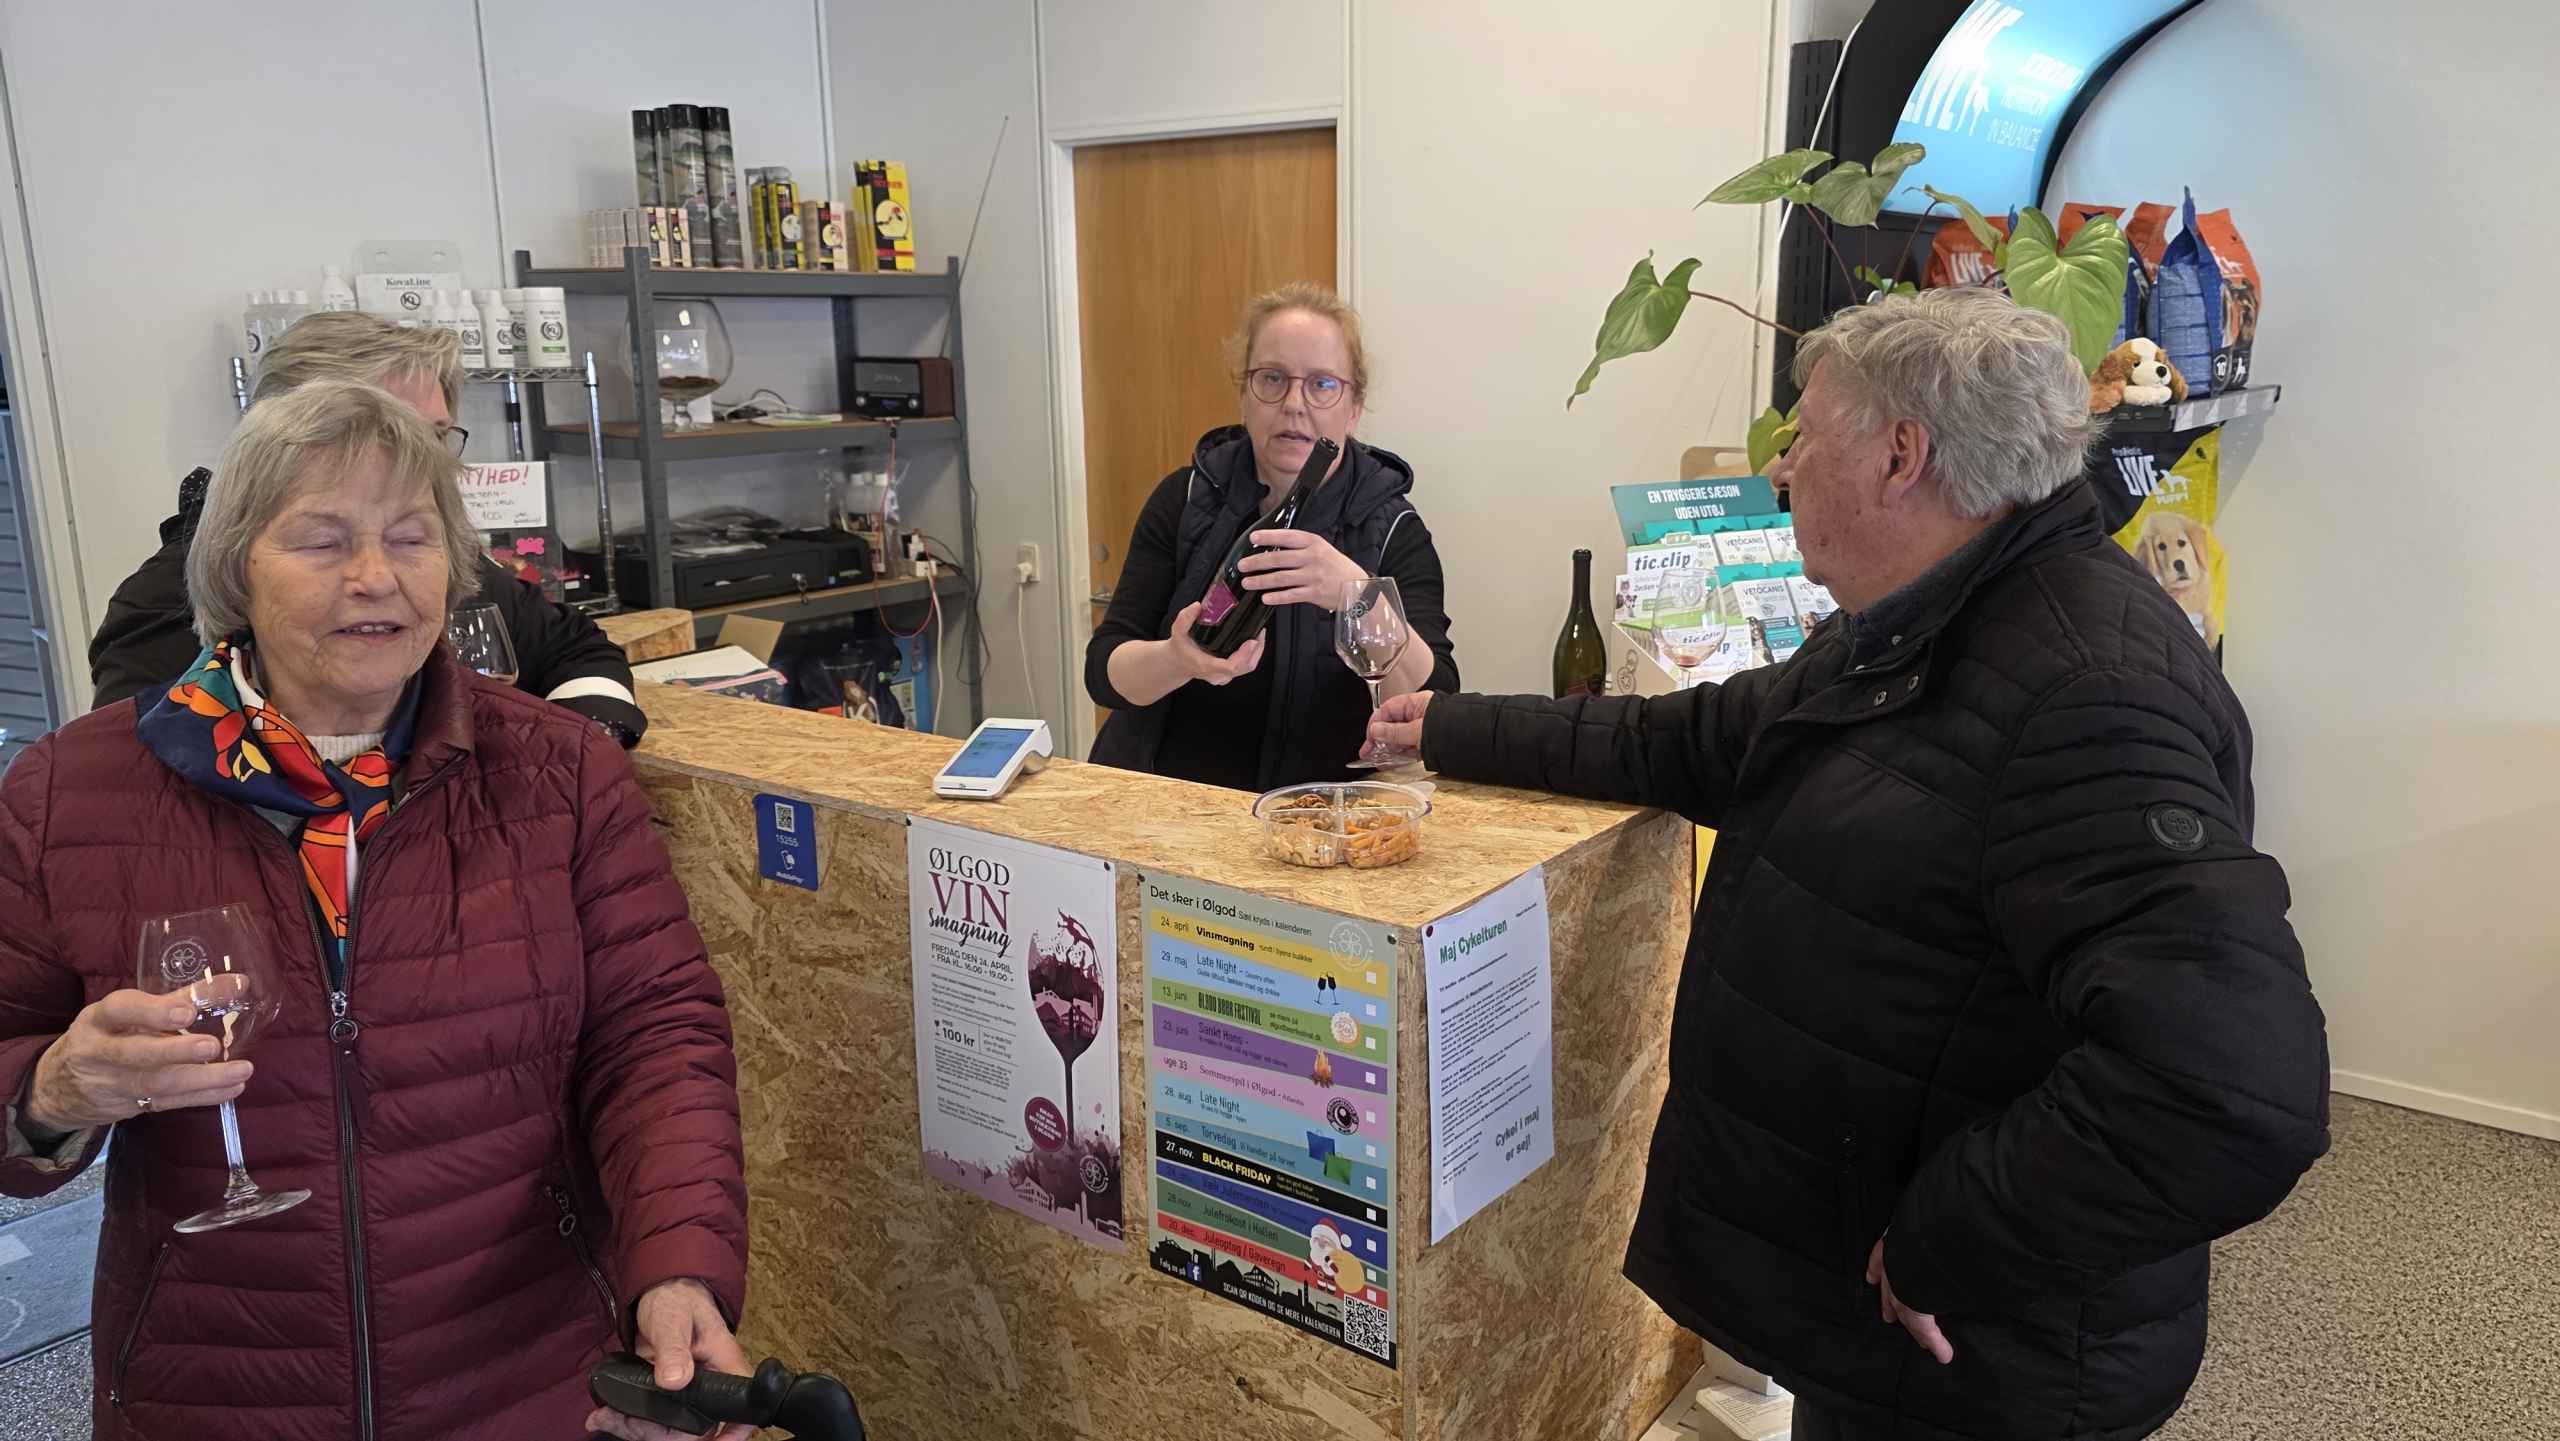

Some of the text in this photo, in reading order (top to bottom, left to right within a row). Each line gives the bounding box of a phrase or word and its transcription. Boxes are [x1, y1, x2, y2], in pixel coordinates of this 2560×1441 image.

[2115, 454, 2165, 497] LIVE
[1647, 485, 1740, 503] EN TRYGGERE SÆSON
[1674, 504, 1725, 520] UDEN UTØJ
[1635, 551, 1691, 572] tic.clip
[929, 847, 1010, 887] ØLGOD
[928, 871, 1010, 933] VIN
[1150, 885, 1169, 901] Det
[1172, 892, 1194, 906] sker
[1202, 898, 1236, 917] Ølgod
[929, 907, 1012, 958] Smagning
[1196, 926, 1254, 951] Vinsmagning
[1439, 919, 1508, 965] Maj Cykelturen
[931, 943, 961, 958] FREDAG
[961, 951, 977, 963] DEN
[937, 953, 951, 965] FRA
[1175, 956, 1187, 968] maj
[1197, 952, 1214, 968] Late
[1216, 957, 1236, 975] Night
[942, 1028, 962, 1043] 100
[963, 1034, 975, 1048] kr
[1198, 1021, 1221, 1039] Sankt
[1223, 1030, 1243, 1045] Hans
[1163, 1056, 1177, 1069] uge
[1200, 1088, 1240, 1113] Late Night
[1495, 1120, 1519, 1147] Cykel
[1524, 1105, 1541, 1127] maj
[1179, 1146, 1194, 1160] nov.
[1202, 1152, 1272, 1185] BLACK FRIDAY
[1203, 1203, 1246, 1229] Julefrokost
[1223, 1282, 1238, 1296] SCAN
[1248, 1293, 1266, 1307] KODEN
[1267, 1299, 1276, 1311] OG
[1277, 1303, 1284, 1315] SE
[1285, 1307, 1300, 1322] MERE
[1304, 1316, 1341, 1338] KALENDEREN
